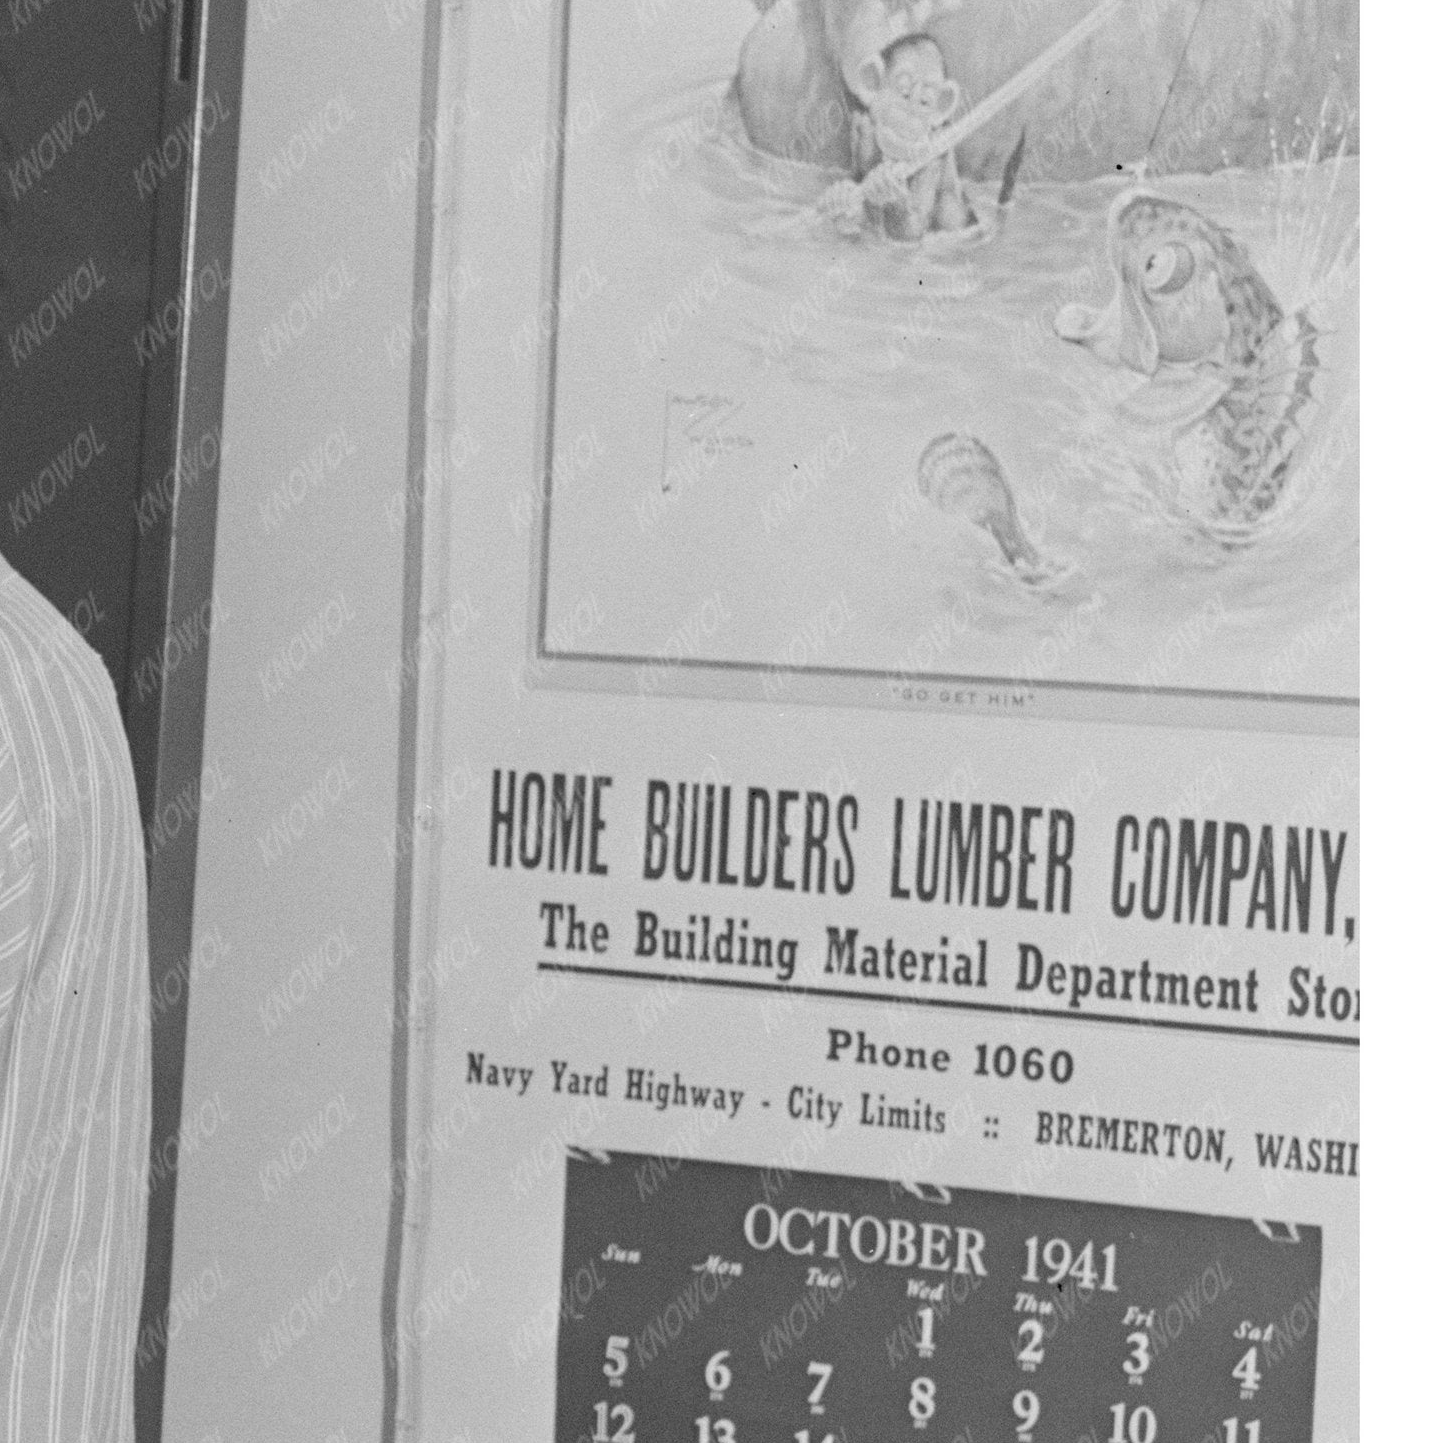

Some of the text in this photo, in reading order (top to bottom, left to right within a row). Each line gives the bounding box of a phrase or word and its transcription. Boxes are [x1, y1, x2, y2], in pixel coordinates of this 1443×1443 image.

[939, 691, 977, 704] GET
[488, 768, 1358, 947] HOME BUILDERS LUMBER COMPANY,
[539, 901, 611, 957] The
[634, 910, 800, 980] Building
[824, 926, 989, 991] Material
[1015, 943, 1260, 1009] Department
[825, 1029, 1076, 1085] Phone 1060
[465, 1050, 534, 1097] Navy
[548, 1061, 615, 1100] Yard
[624, 1068, 745, 1121] Highway
[786, 1085, 844, 1132] City
[858, 1092, 948, 1136] Limits
[1035, 1110, 1236, 1173] BREMERTON,
[601, 1243, 641, 1264] Sun
[805, 1266, 843, 1289] Tue
[905, 1279, 945, 1303] Wed
[1013, 1292, 1054, 1315] Thu
[1122, 1306, 1155, 1327] Fri
[1233, 1320, 1274, 1342] Sat
[743, 1202, 1118, 1293] OCTOBER 1941
[603, 1335, 630, 1379] 5
[705, 1349, 732, 1392] 6
[807, 1360, 833, 1404] 7
[908, 1376, 936, 1421] 8
[1012, 1390, 1041, 1434] 9
[916, 1306, 1262, 1391] 1 2 3 4
